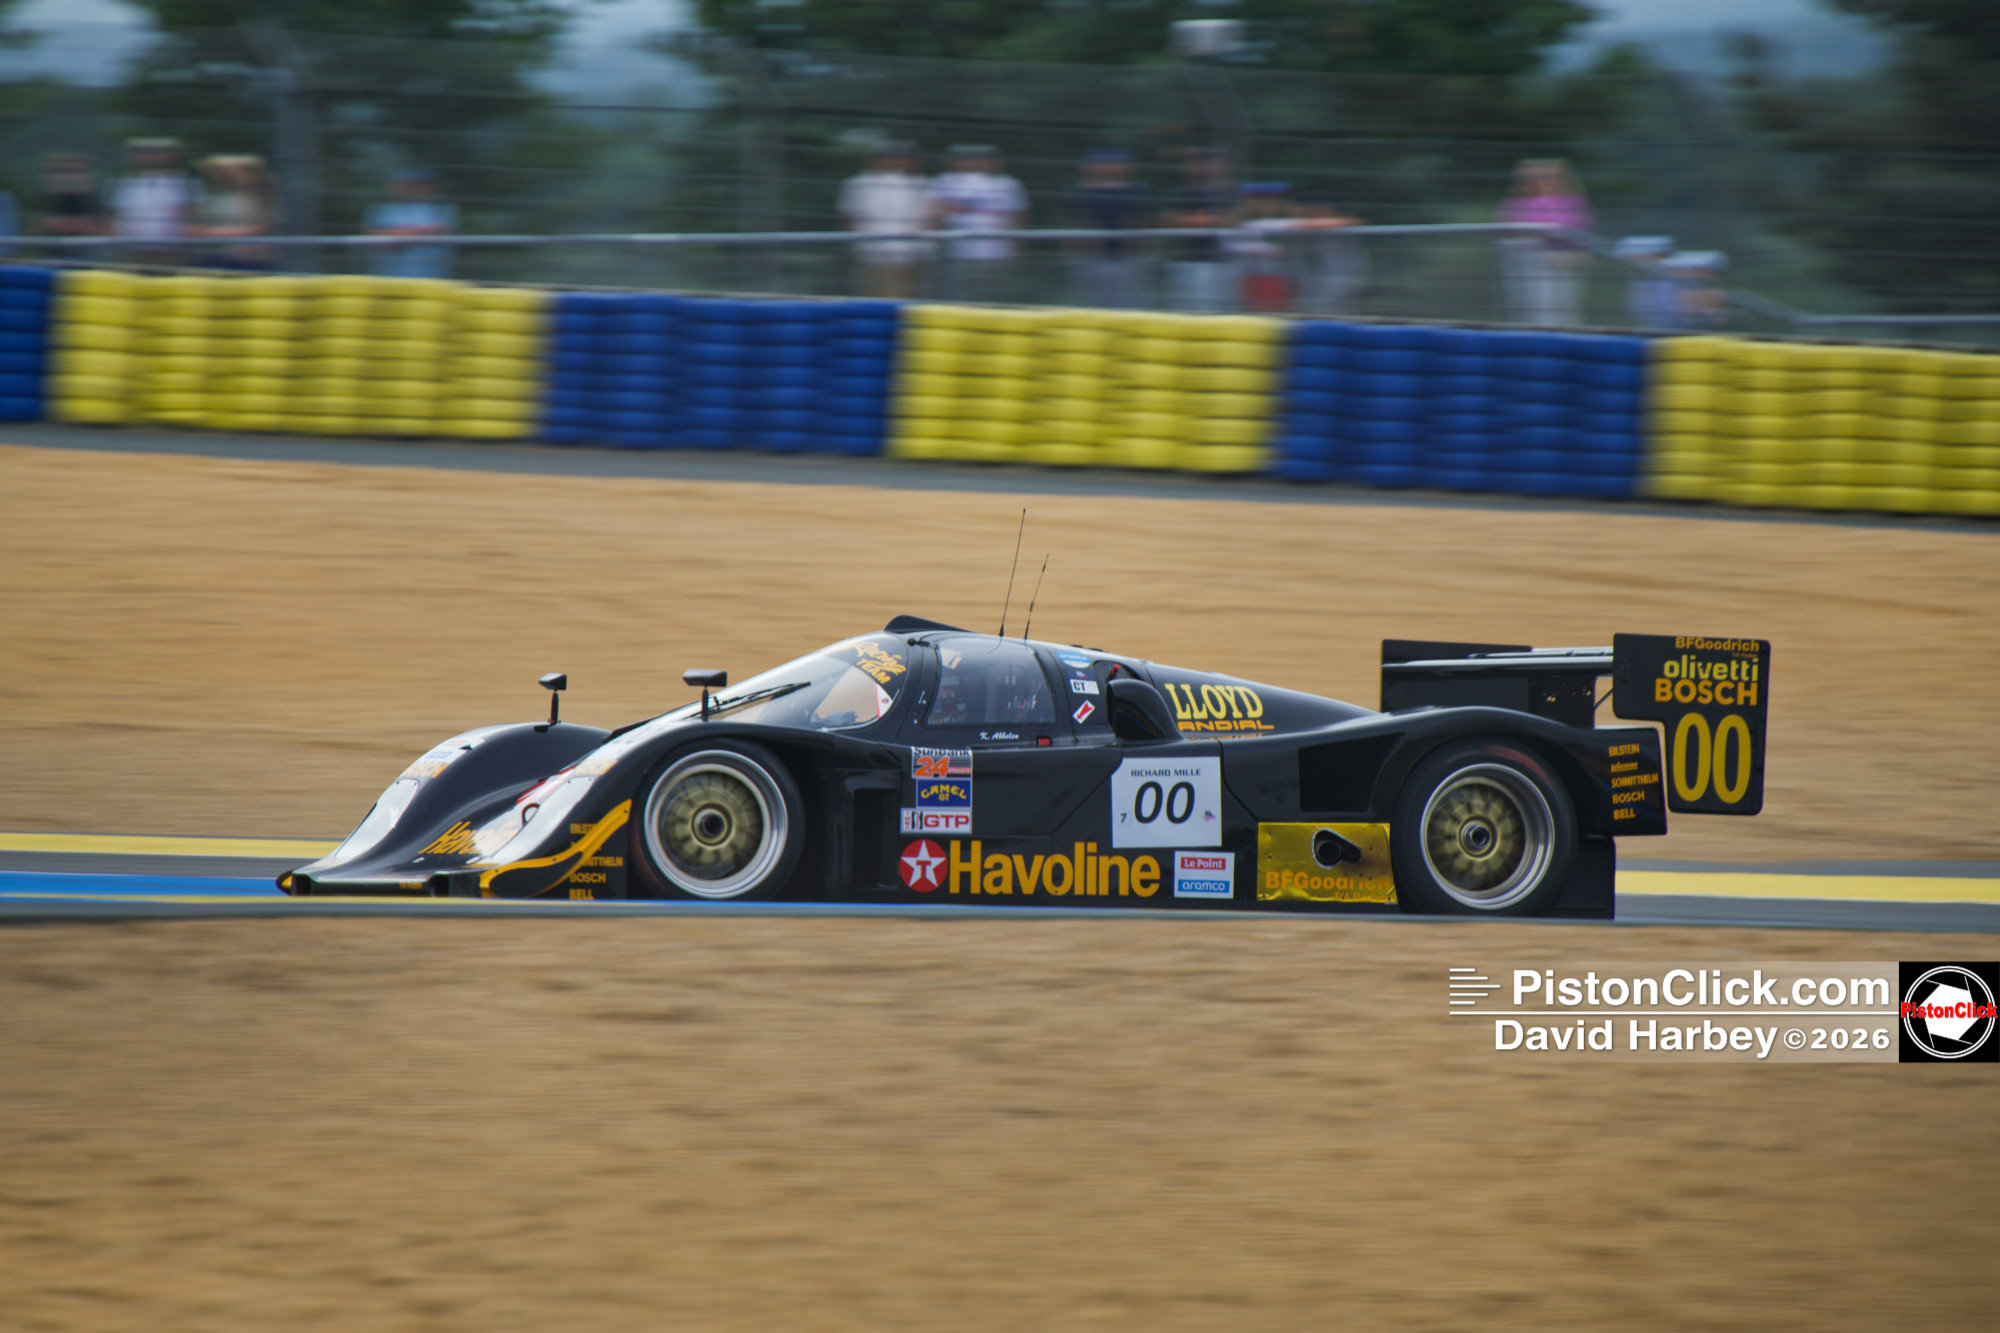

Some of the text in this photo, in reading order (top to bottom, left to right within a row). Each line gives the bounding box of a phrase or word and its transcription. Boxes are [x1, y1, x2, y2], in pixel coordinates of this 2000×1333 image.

[1675, 636, 1759, 652] BFGoodrich
[1664, 654, 1759, 682] olivetti
[1655, 678, 1758, 706] BOSCH
[1164, 683, 1263, 720] LLOYD
[1177, 720, 1275, 732] ANDIAL
[1609, 743, 1640, 757] BILSTEIN
[1673, 712, 1752, 804] 00
[915, 756, 950, 777] 24
[1131, 768, 1201, 777] RICHARD MILLE
[920, 784, 966, 800] CAMEL
[938, 793, 950, 801] GT
[1612, 790, 1645, 804] BOSCH
[1134, 781, 1195, 824] 00
[923, 814, 970, 828] GTP
[1613, 808, 1636, 820] BELL
[949, 840, 1161, 898] Havoline
[1184, 859, 1222, 869] Le Point
[1182, 881, 1226, 892] aramco
